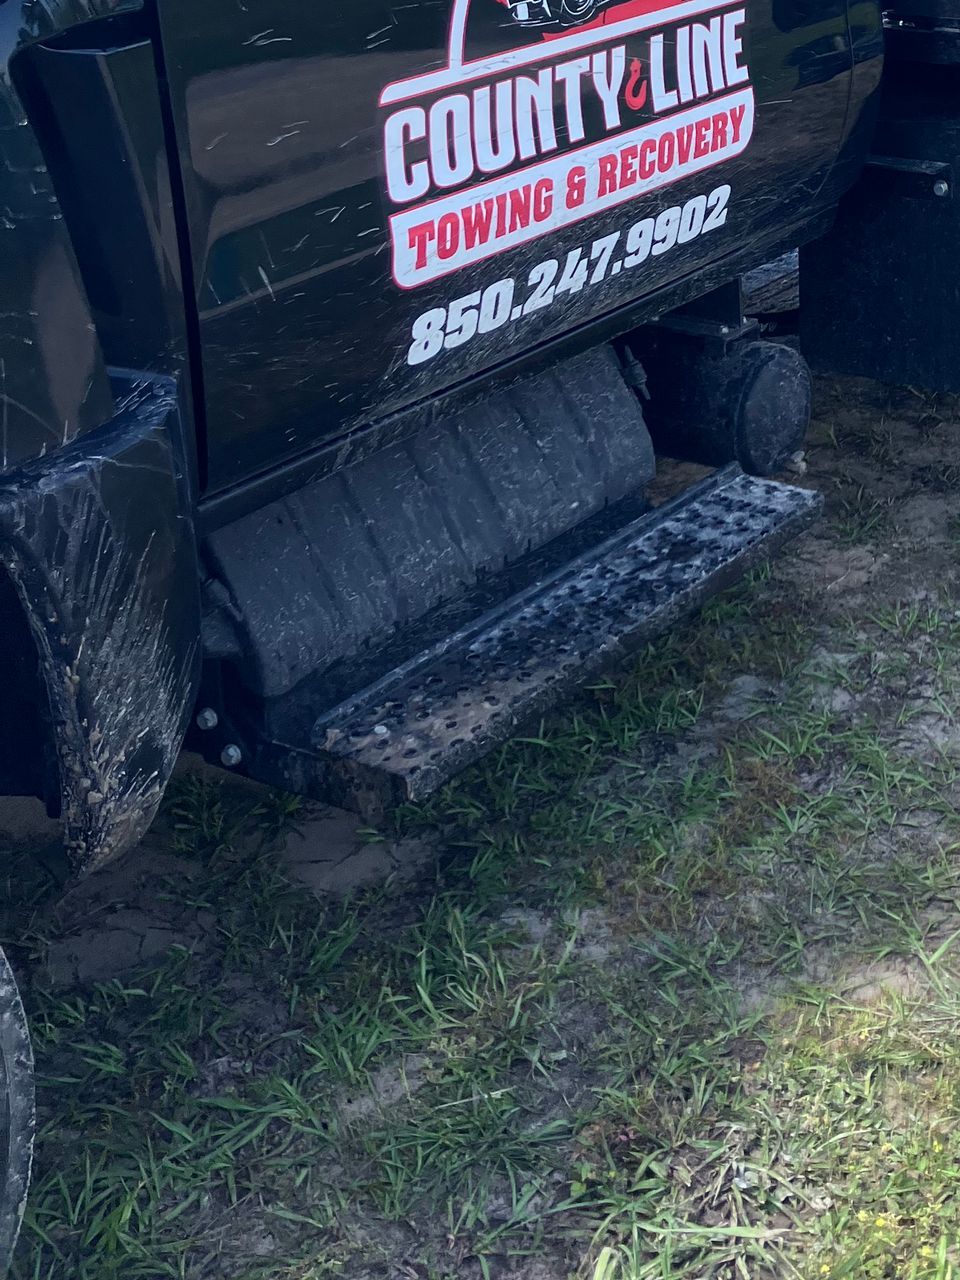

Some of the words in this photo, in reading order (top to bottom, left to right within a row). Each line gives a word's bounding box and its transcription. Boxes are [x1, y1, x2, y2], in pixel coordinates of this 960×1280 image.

[383, 45, 627, 204] COUNTY
[649, 9, 750, 114] LINE
[407, 177, 554, 270] TOWING
[565, 165, 587, 210] &
[597, 103, 746, 199] RECOVERY
[406, 184, 732, 366] 850.247.9902
